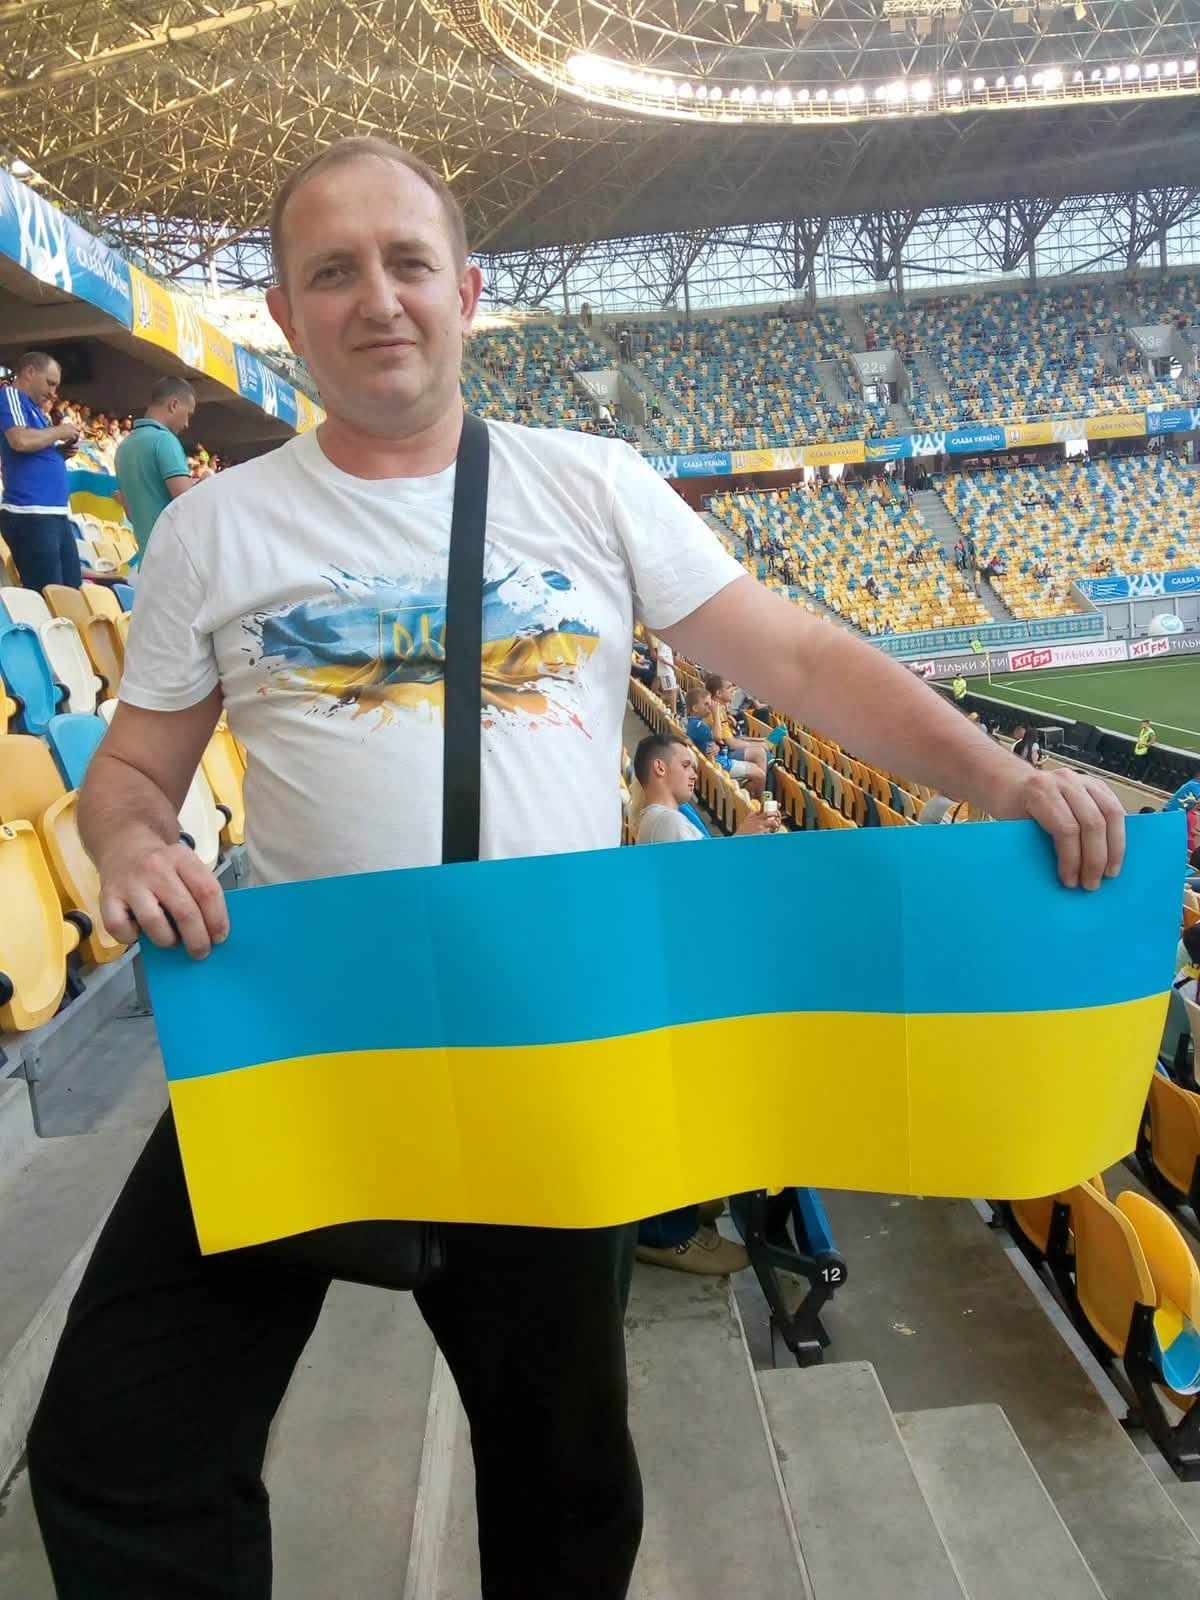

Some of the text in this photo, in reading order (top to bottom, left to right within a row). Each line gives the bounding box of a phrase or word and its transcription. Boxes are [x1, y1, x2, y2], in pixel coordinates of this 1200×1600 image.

[937, 660, 977, 673] ТІЛЬКИ
[980, 656, 1009, 670] ХТИ!
[821, 1267, 841, 1283] 12
